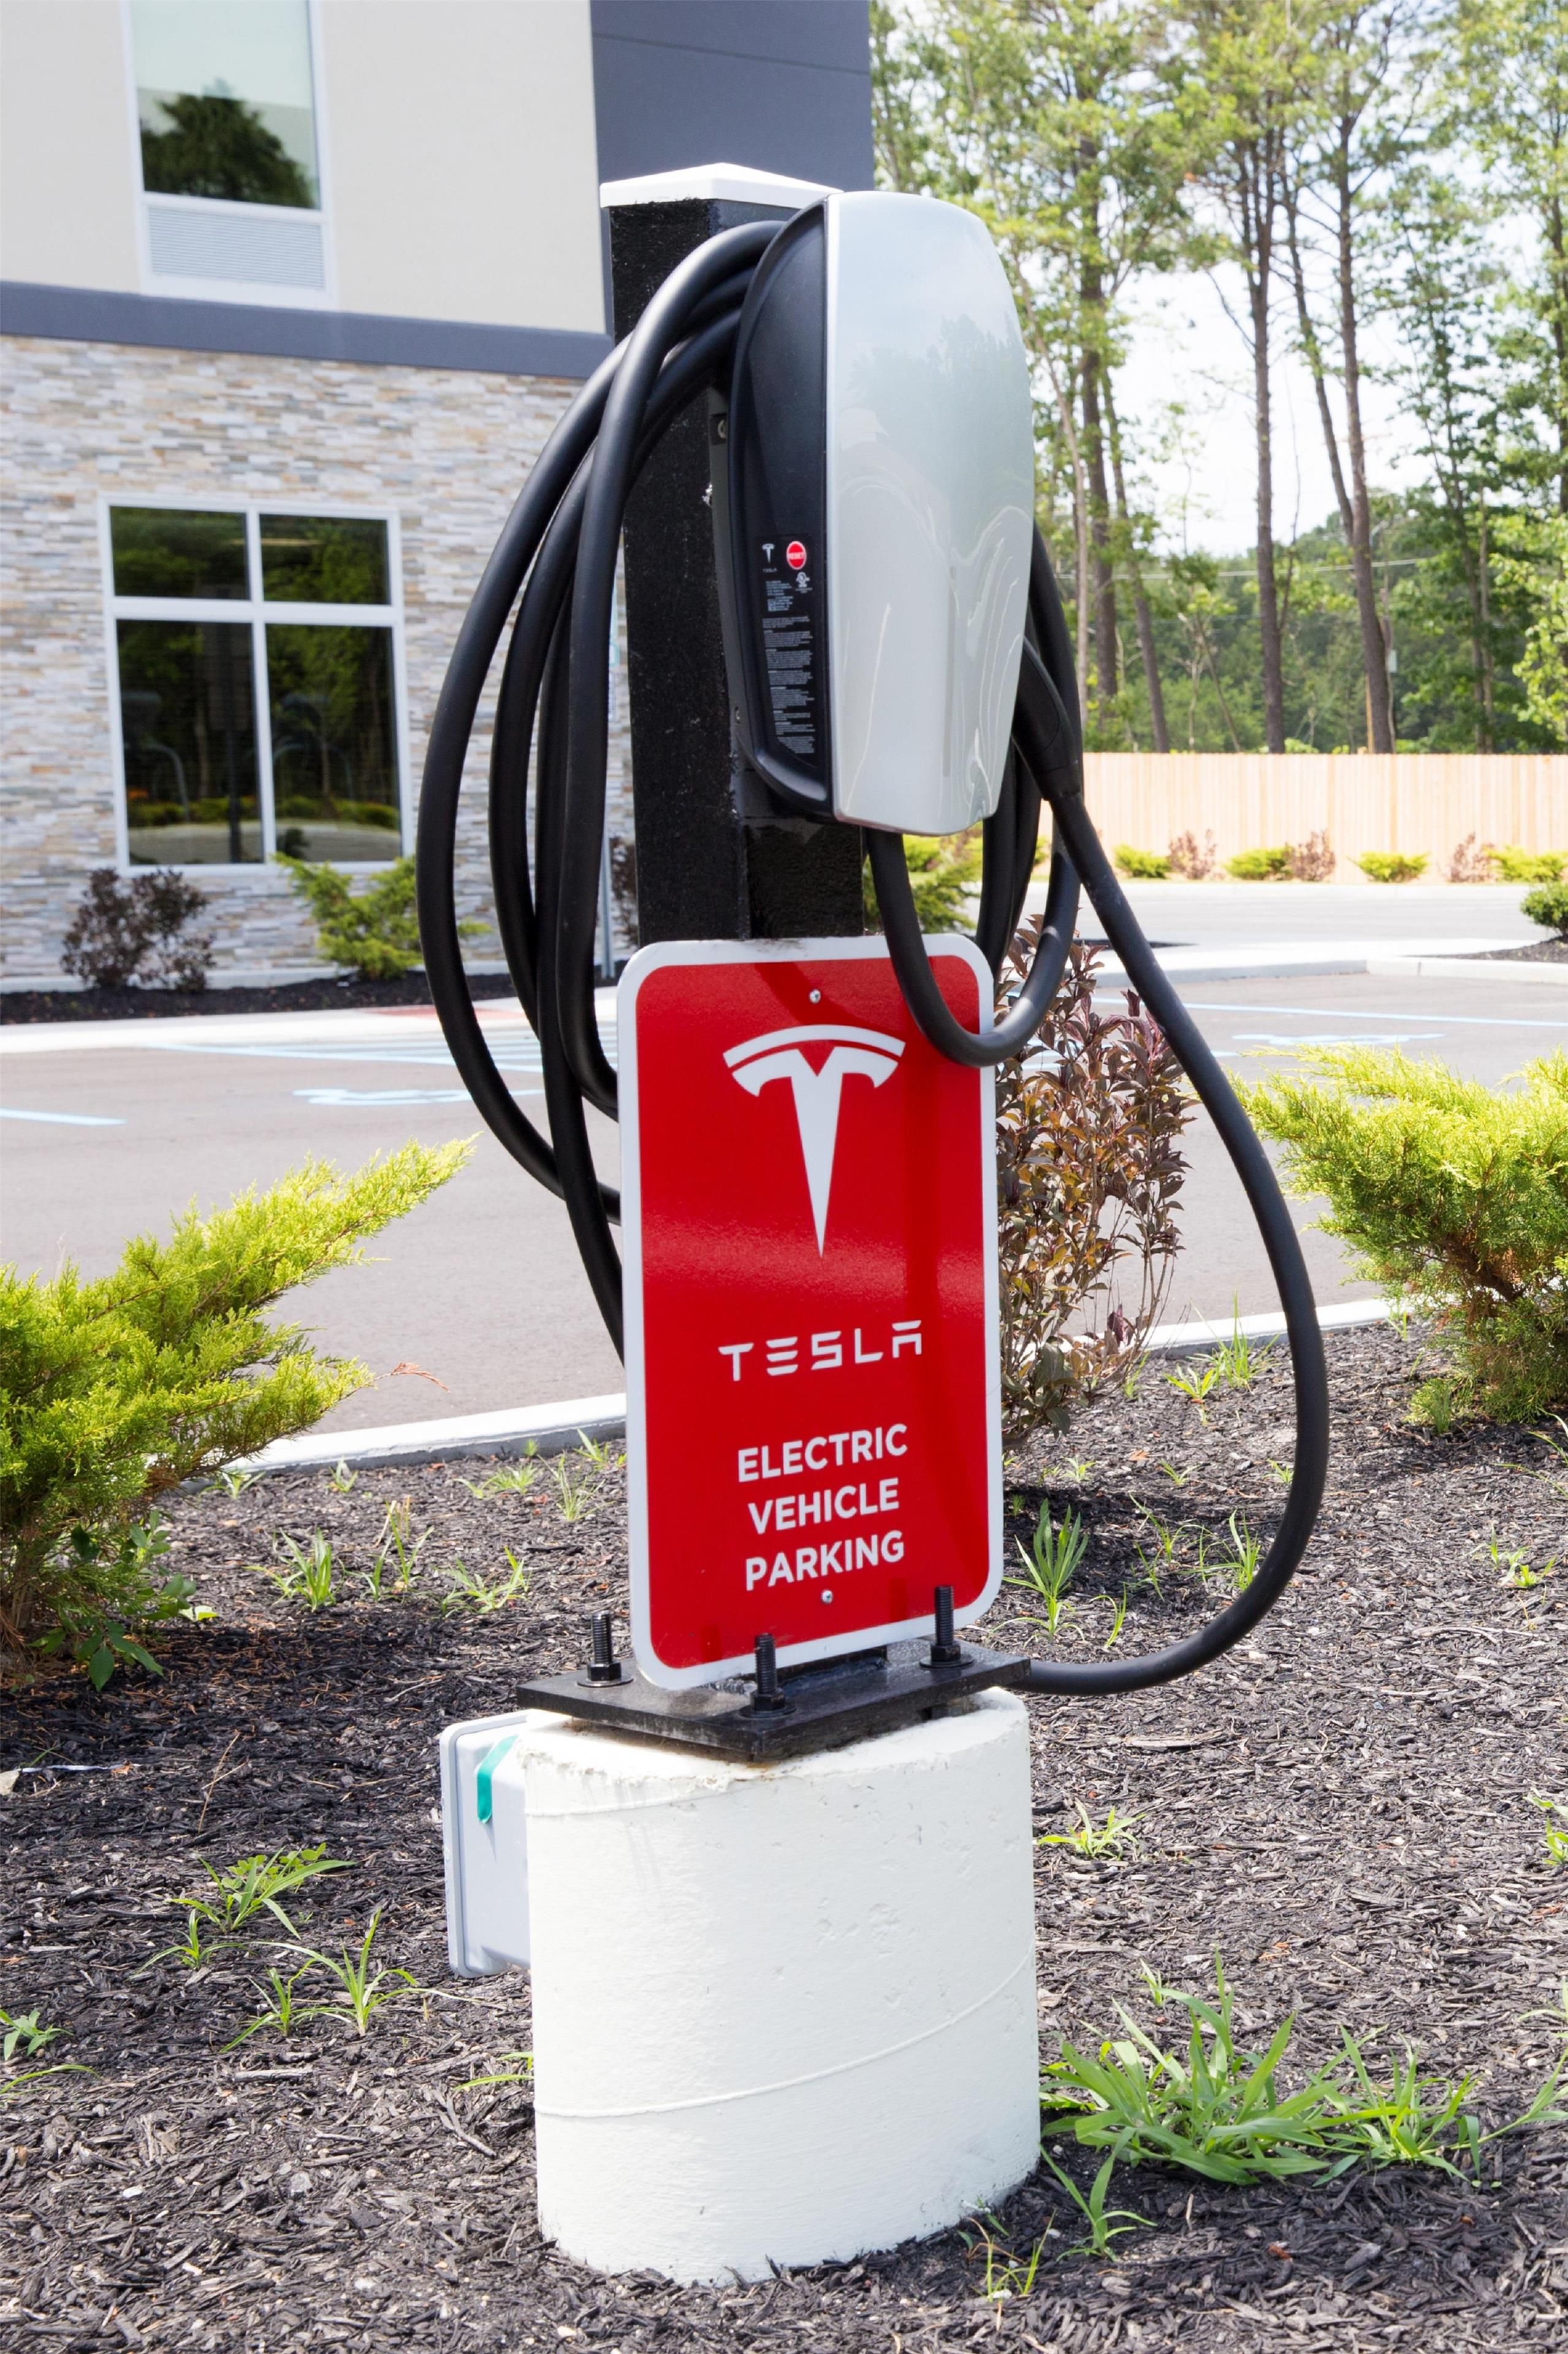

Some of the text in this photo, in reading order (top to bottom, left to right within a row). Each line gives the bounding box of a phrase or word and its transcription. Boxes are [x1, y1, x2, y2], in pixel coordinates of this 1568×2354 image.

[718, 1320, 922, 1381] TESLA
[738, 1423, 908, 1482] ELECTRIC
[748, 1477, 899, 1534] VEHICLE
[746, 1530, 904, 1591] PARKING
